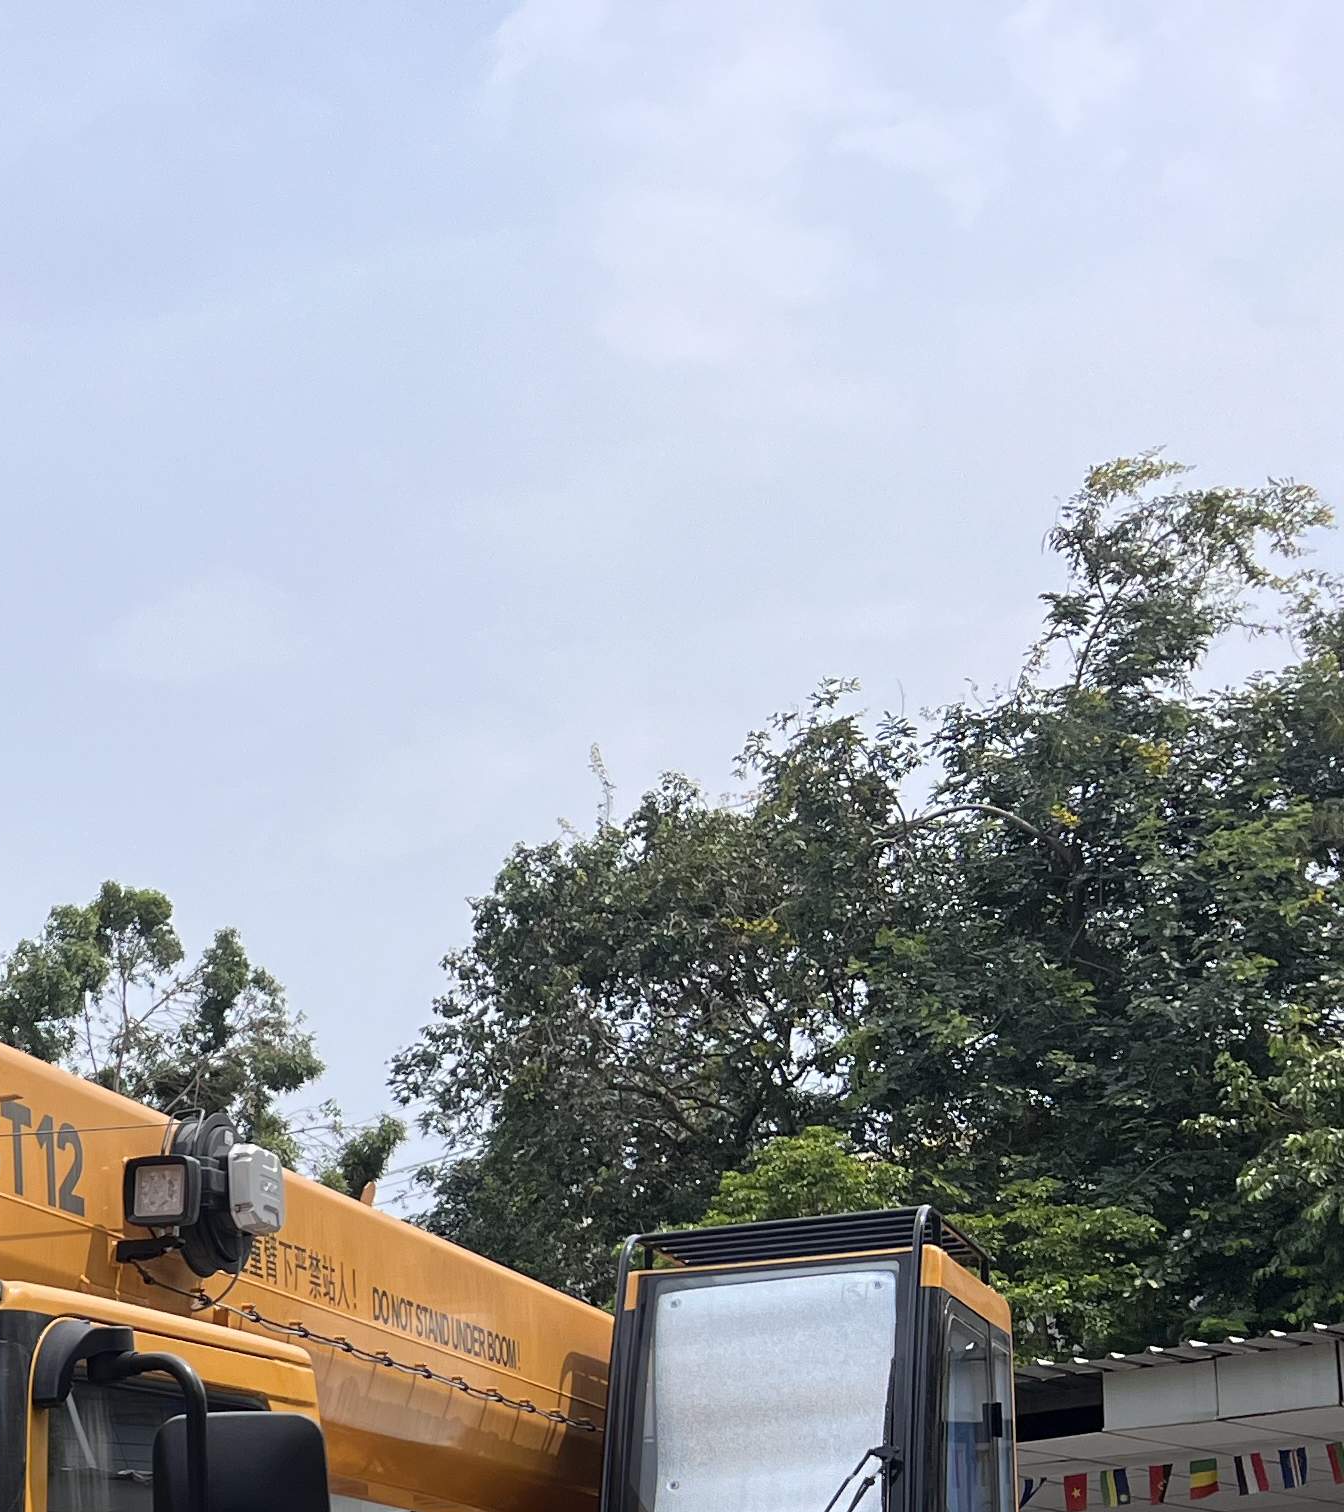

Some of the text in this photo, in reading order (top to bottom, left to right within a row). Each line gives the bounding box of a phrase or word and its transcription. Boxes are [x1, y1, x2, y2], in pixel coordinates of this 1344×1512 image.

[242, 1232, 357, 1310] 重臂下严禁站人！
[372, 1286, 390, 1325] DO
[391, 1293, 414, 1333] NOT
[416, 1303, 450, 1347] STAND
[450, 1316, 487, 1359] UNDER
